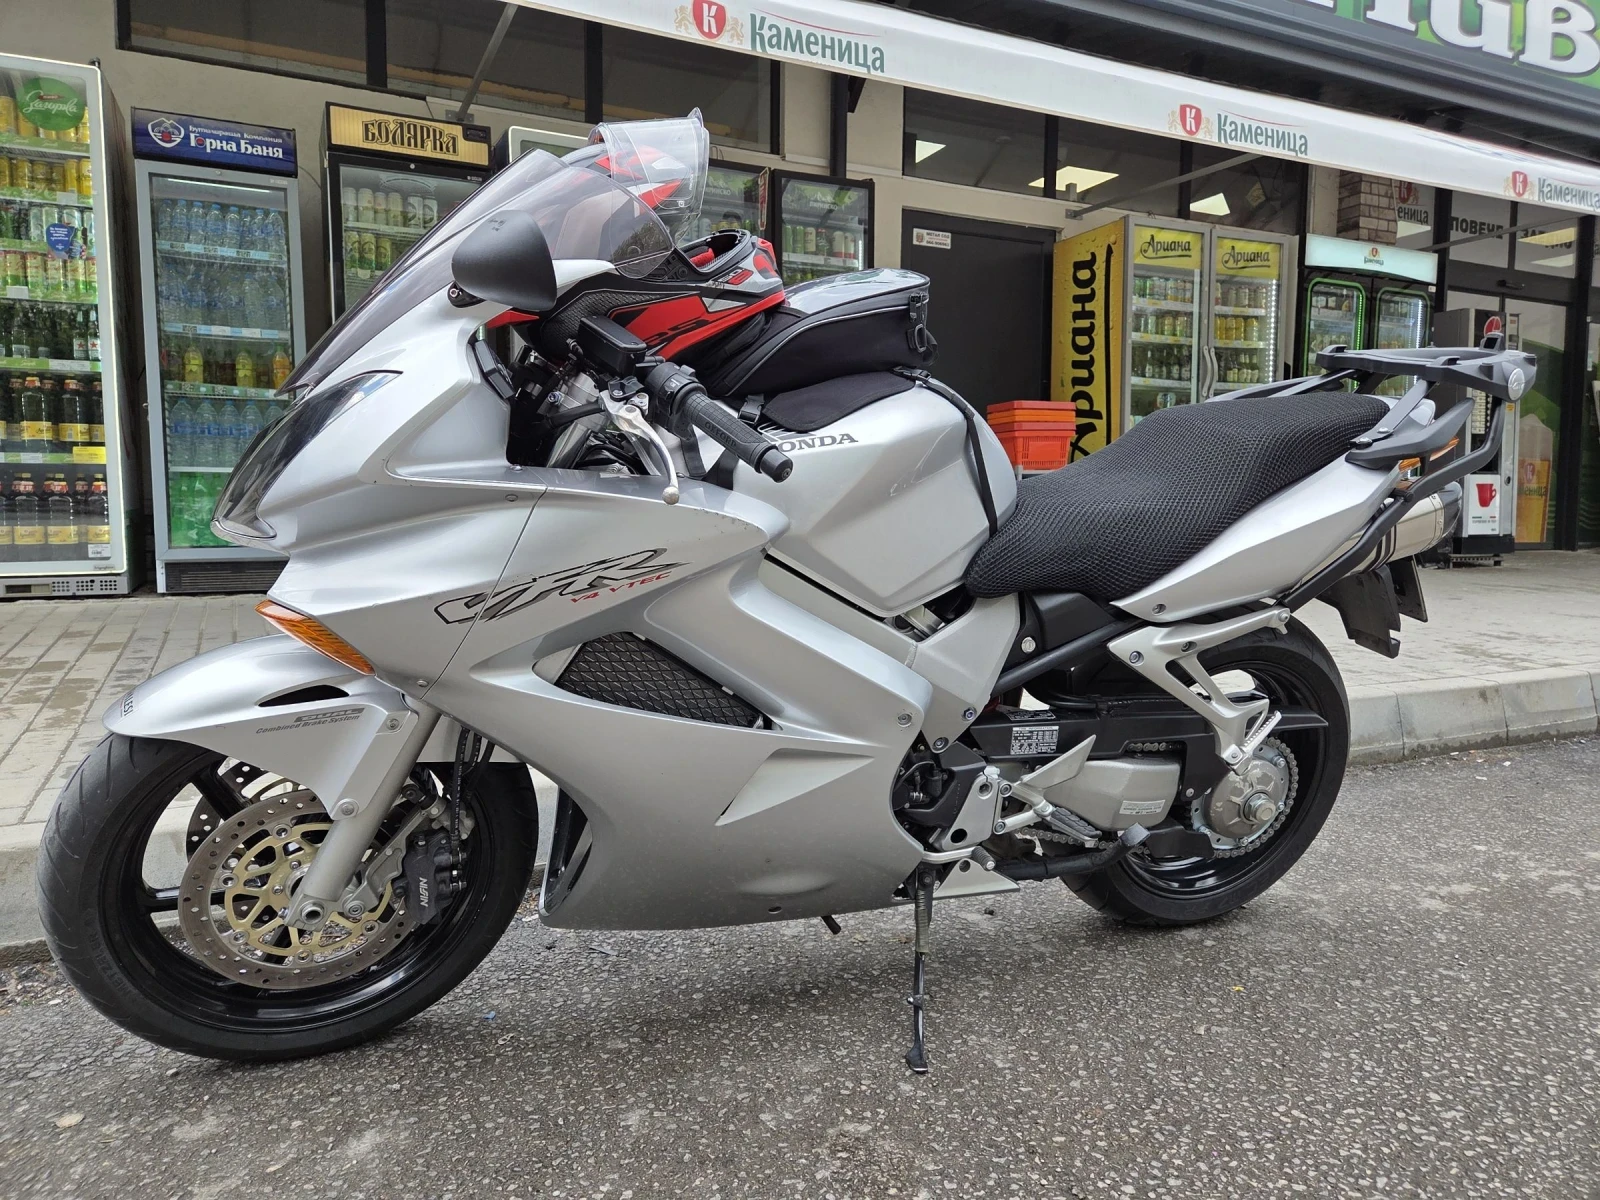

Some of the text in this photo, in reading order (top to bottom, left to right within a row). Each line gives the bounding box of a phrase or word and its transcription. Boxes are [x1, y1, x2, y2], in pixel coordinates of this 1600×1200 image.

[749, 13, 886, 74] Каменица
[189, 132, 284, 159] Горна Баня
[362, 119, 460, 156] БОЛЯРКА
[1217, 113, 1309, 156] Каменица
[1537, 177, 1600, 211] Каменица
[1397, 206, 1430, 225] еница
[1140, 233, 1192, 259] Ариана
[1222, 245, 1271, 269] Ариана
[704, 420, 738, 449] OXFORD
[775, 432, 859, 454] ONDA
[570, 570, 674, 604] V4 VTEC
[256, 714, 360, 735] Combined Brake System
[419, 877, 429, 908] NISSIN
